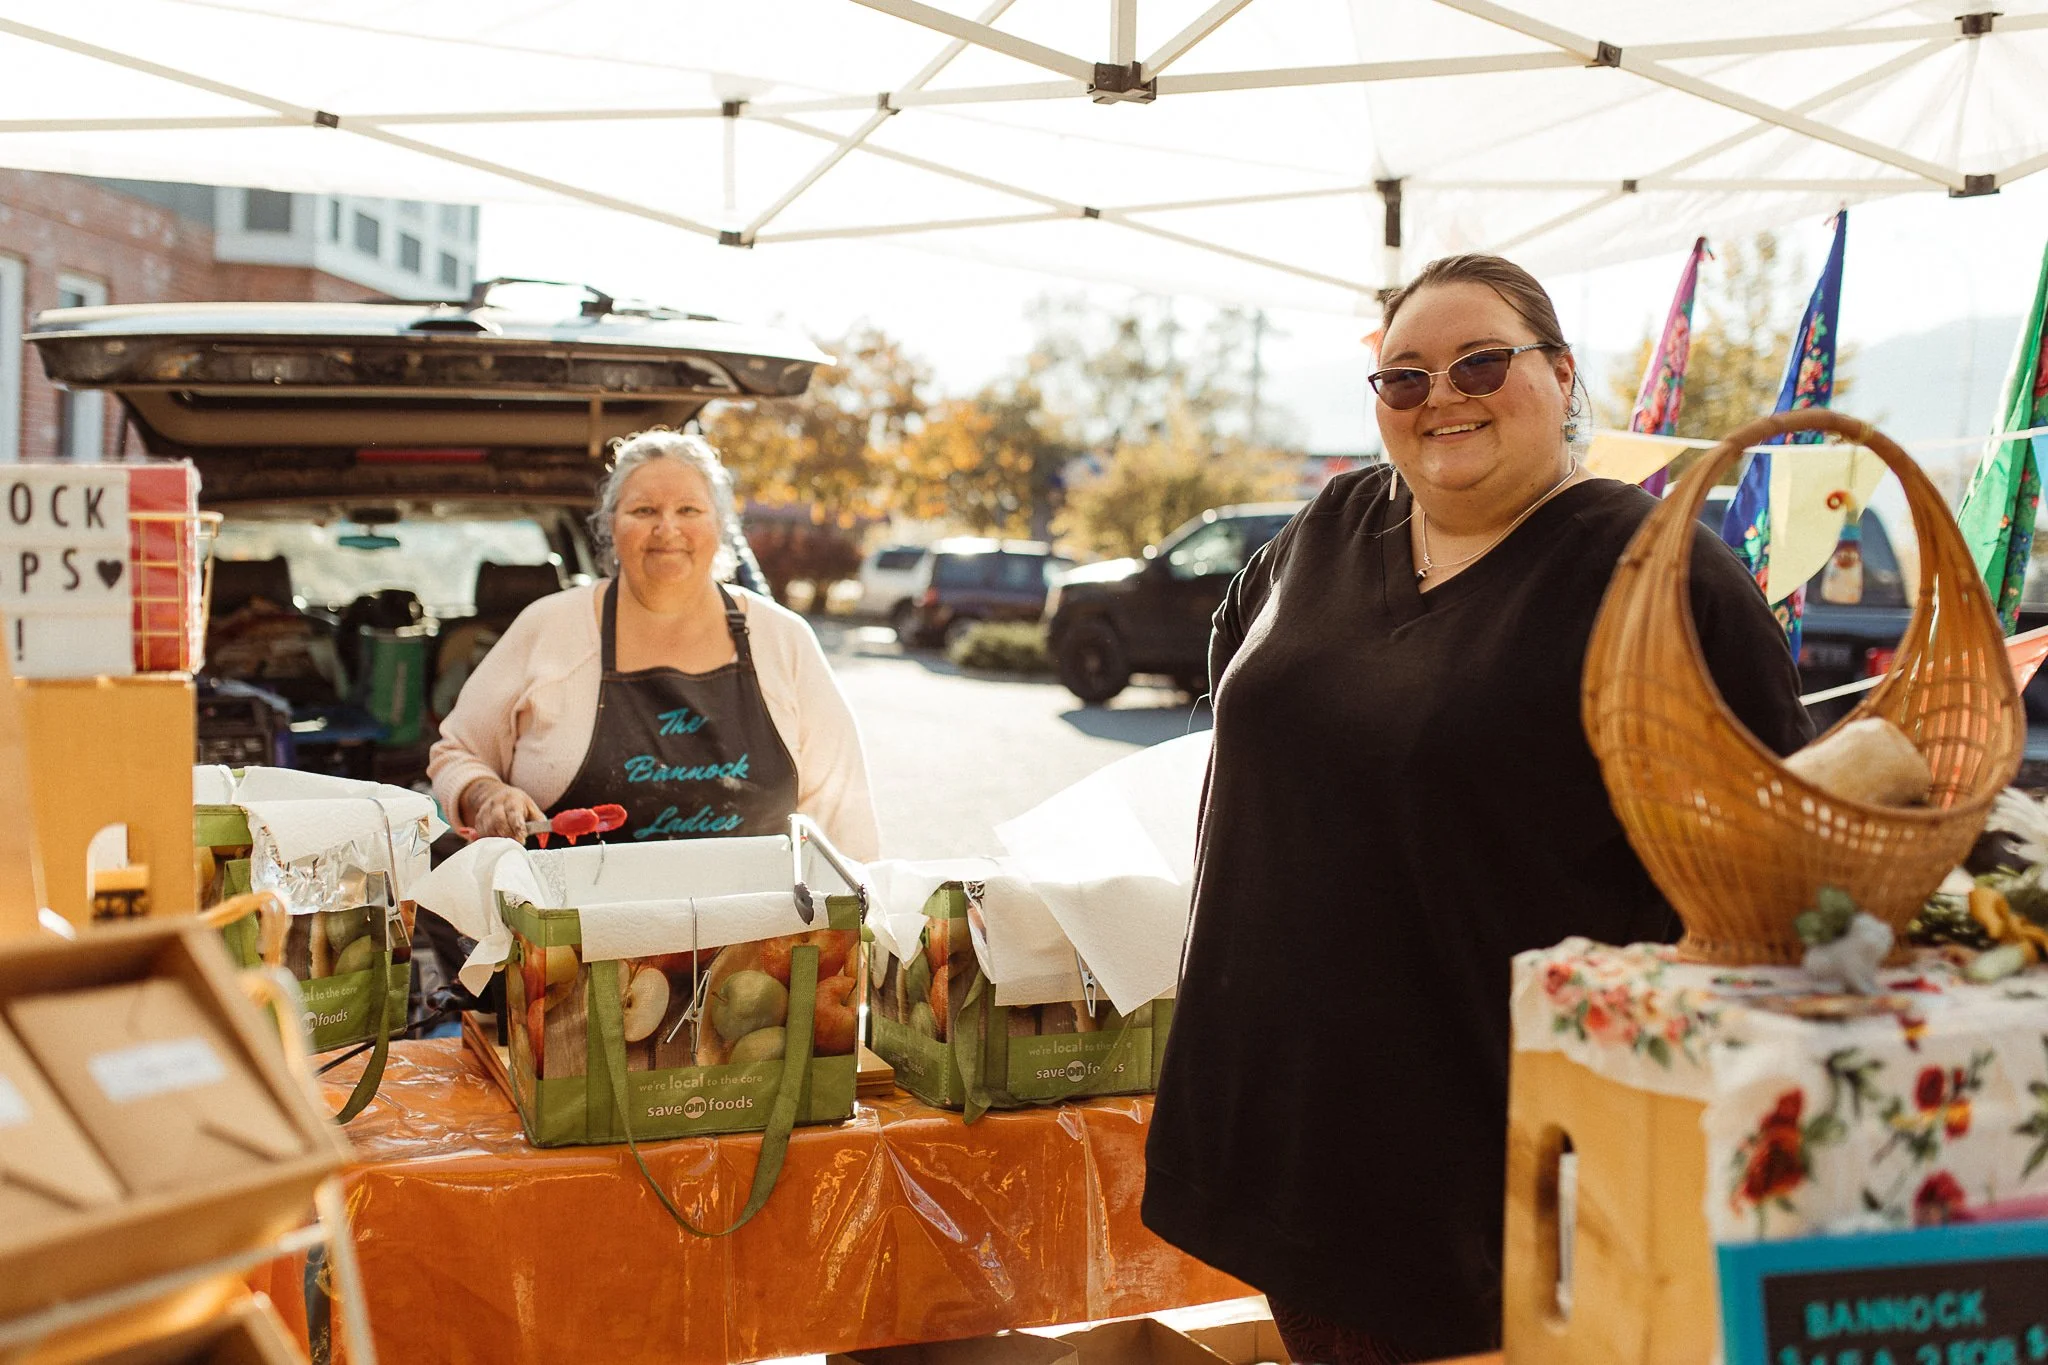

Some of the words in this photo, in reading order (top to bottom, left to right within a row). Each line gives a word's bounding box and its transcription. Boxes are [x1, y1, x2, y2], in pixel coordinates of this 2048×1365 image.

[9, 482, 105, 529] OCK
[657, 707, 710, 736] The
[623, 753, 750, 783] Bannock
[633, 805, 744, 839] Ladies
[326, 987, 340, 999] the
[318, 1008, 348, 1027] foods
[1053, 1038, 1082, 1053] local
[639, 1080, 666, 1092] we're
[669, 1072, 704, 1089] local
[707, 1078, 718, 1087] to
[720, 1074, 738, 1085] the
[740, 1074, 763, 1085] core
[709, 1095, 753, 1111] foods
[1804, 1289, 1987, 1339] BANNOCK
